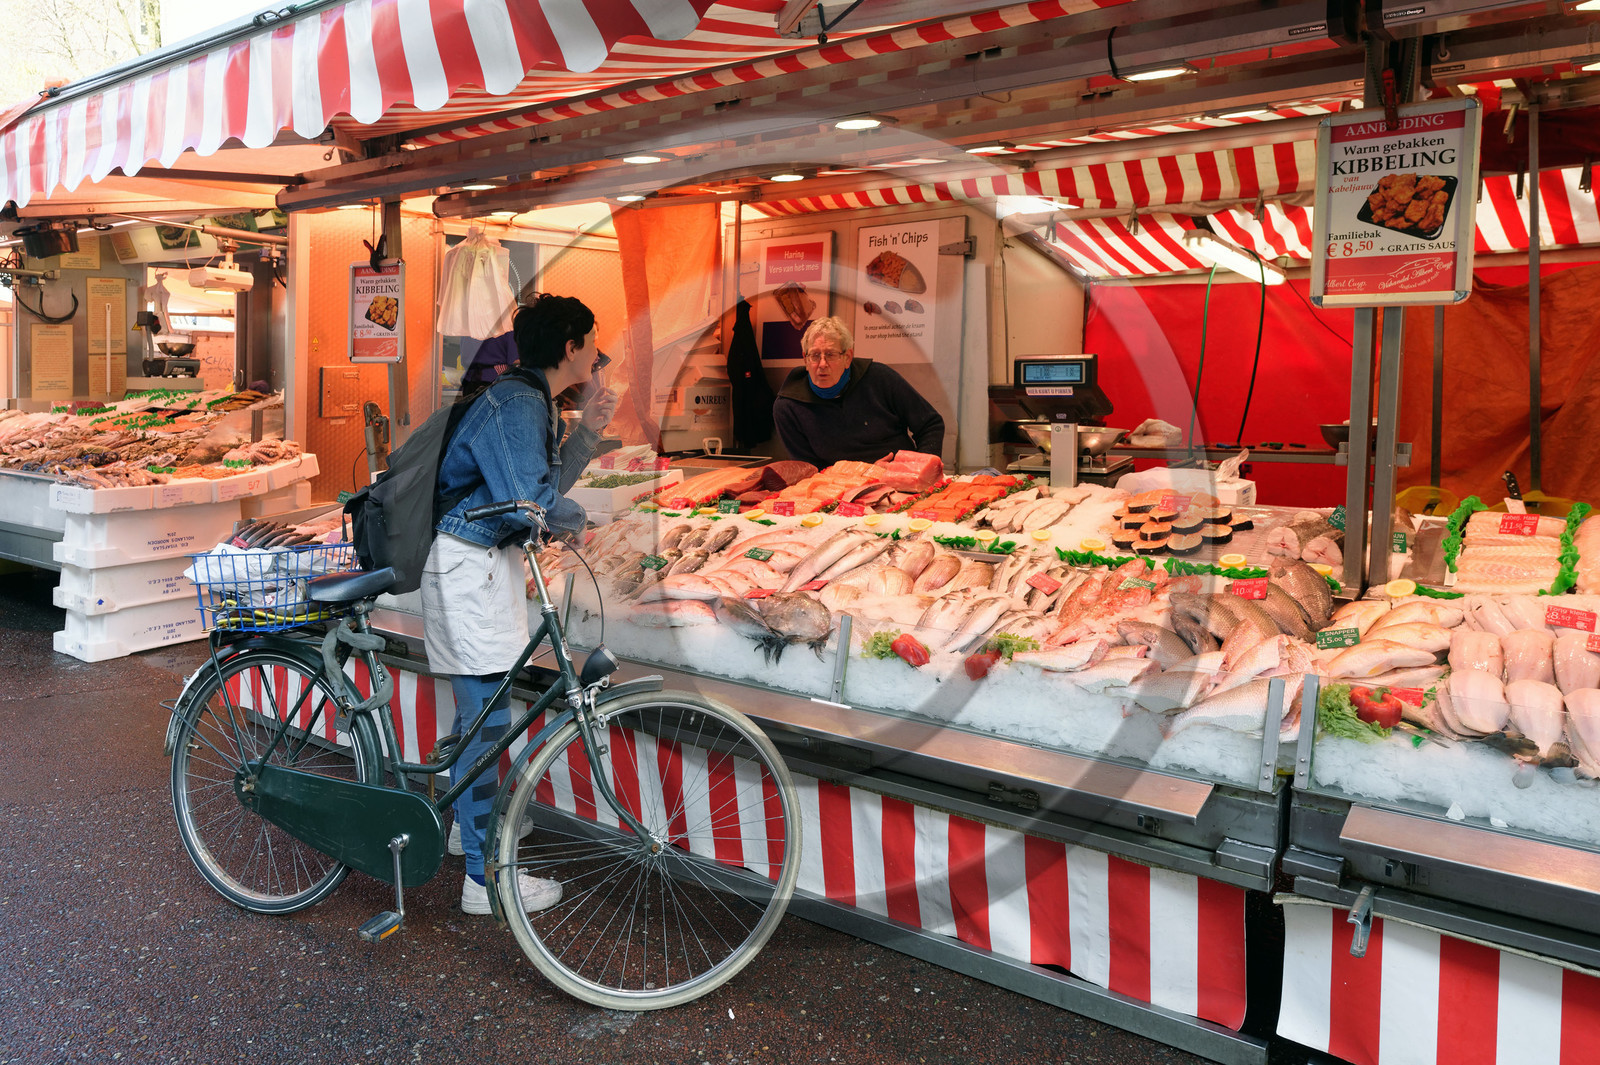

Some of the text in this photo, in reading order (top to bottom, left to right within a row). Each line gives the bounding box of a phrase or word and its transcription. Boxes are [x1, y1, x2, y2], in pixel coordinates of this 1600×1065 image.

[1345, 115, 1444, 136] AANBEDING
[1344, 138, 1445, 156] Warm gebakken
[1332, 149, 1456, 176] KIBBELING
[1328, 183, 1375, 194] Kabeljauw
[869, 234, 888, 247] Fish
[901, 232, 929, 247] Chips
[1328, 230, 1382, 241] Familiebak
[1387, 243, 1426, 253] GRATIS
[1428, 241, 1456, 250] SAUS
[784, 250, 805, 261] Haring
[768, 263, 820, 274] Vers van het mes
[356, 284, 399, 294] KIBBELING
[701, 395, 727, 405] NIREUS
[1325, 629, 1356, 637] SNAPPER
[476, 742, 499, 767] GAZELLE
